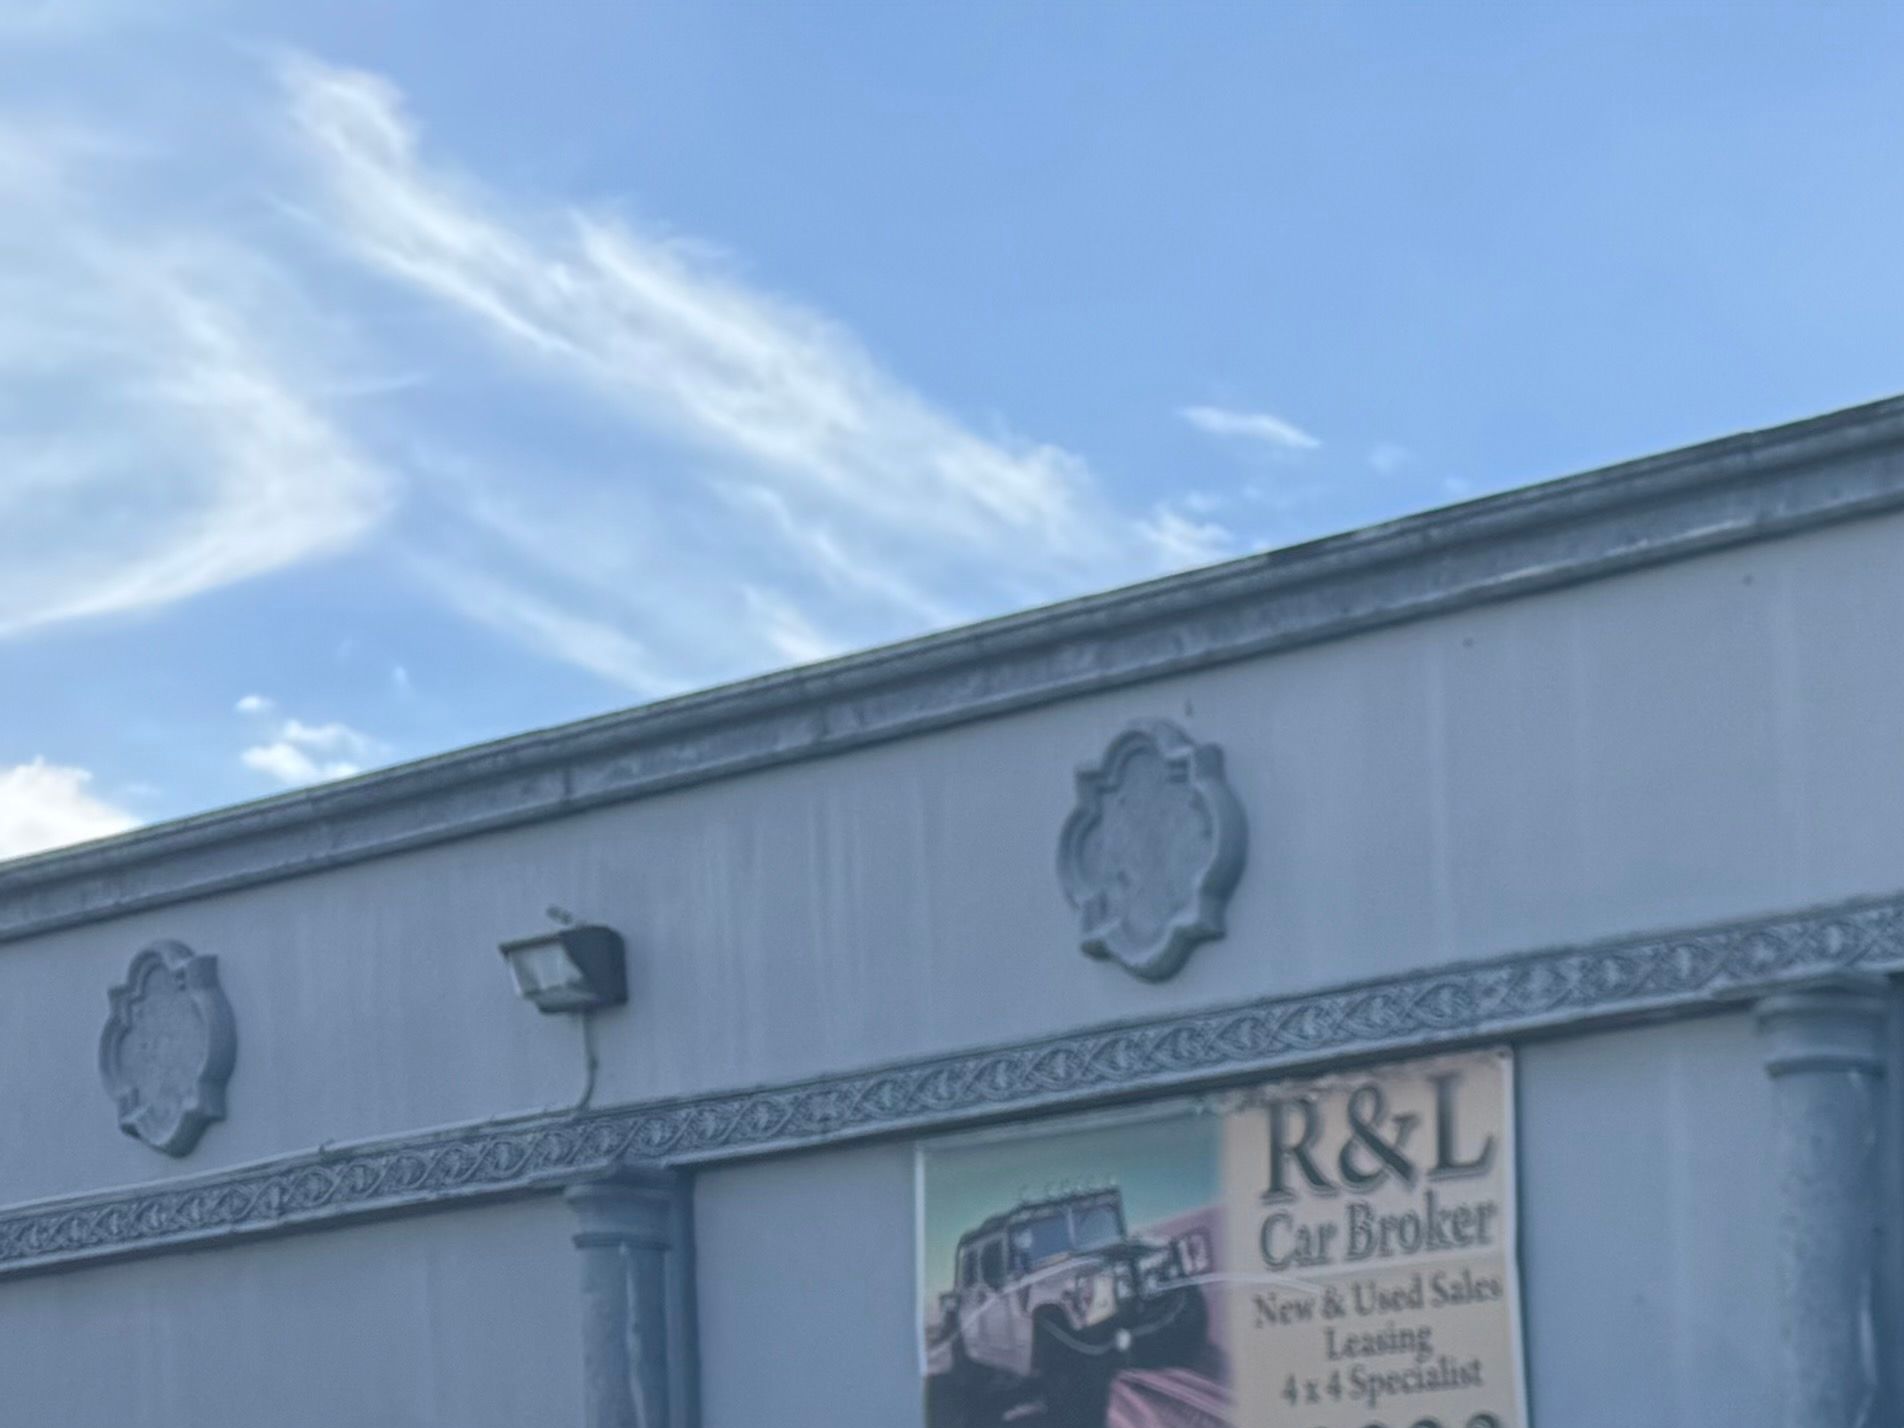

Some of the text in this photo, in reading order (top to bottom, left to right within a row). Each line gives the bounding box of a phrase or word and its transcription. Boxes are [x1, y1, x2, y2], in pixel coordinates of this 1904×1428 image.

[1260, 1070, 1496, 1204] R&L
[1261, 1188, 1497, 1272] Car Broker
[1253, 1266, 1503, 1328] New & Used Sales
[1324, 1321, 1434, 1363] Leasing
[1282, 1372, 1299, 1407] 4
[1325, 1368, 1343, 1401] 4
[1349, 1355, 1485, 1408] Specialist
